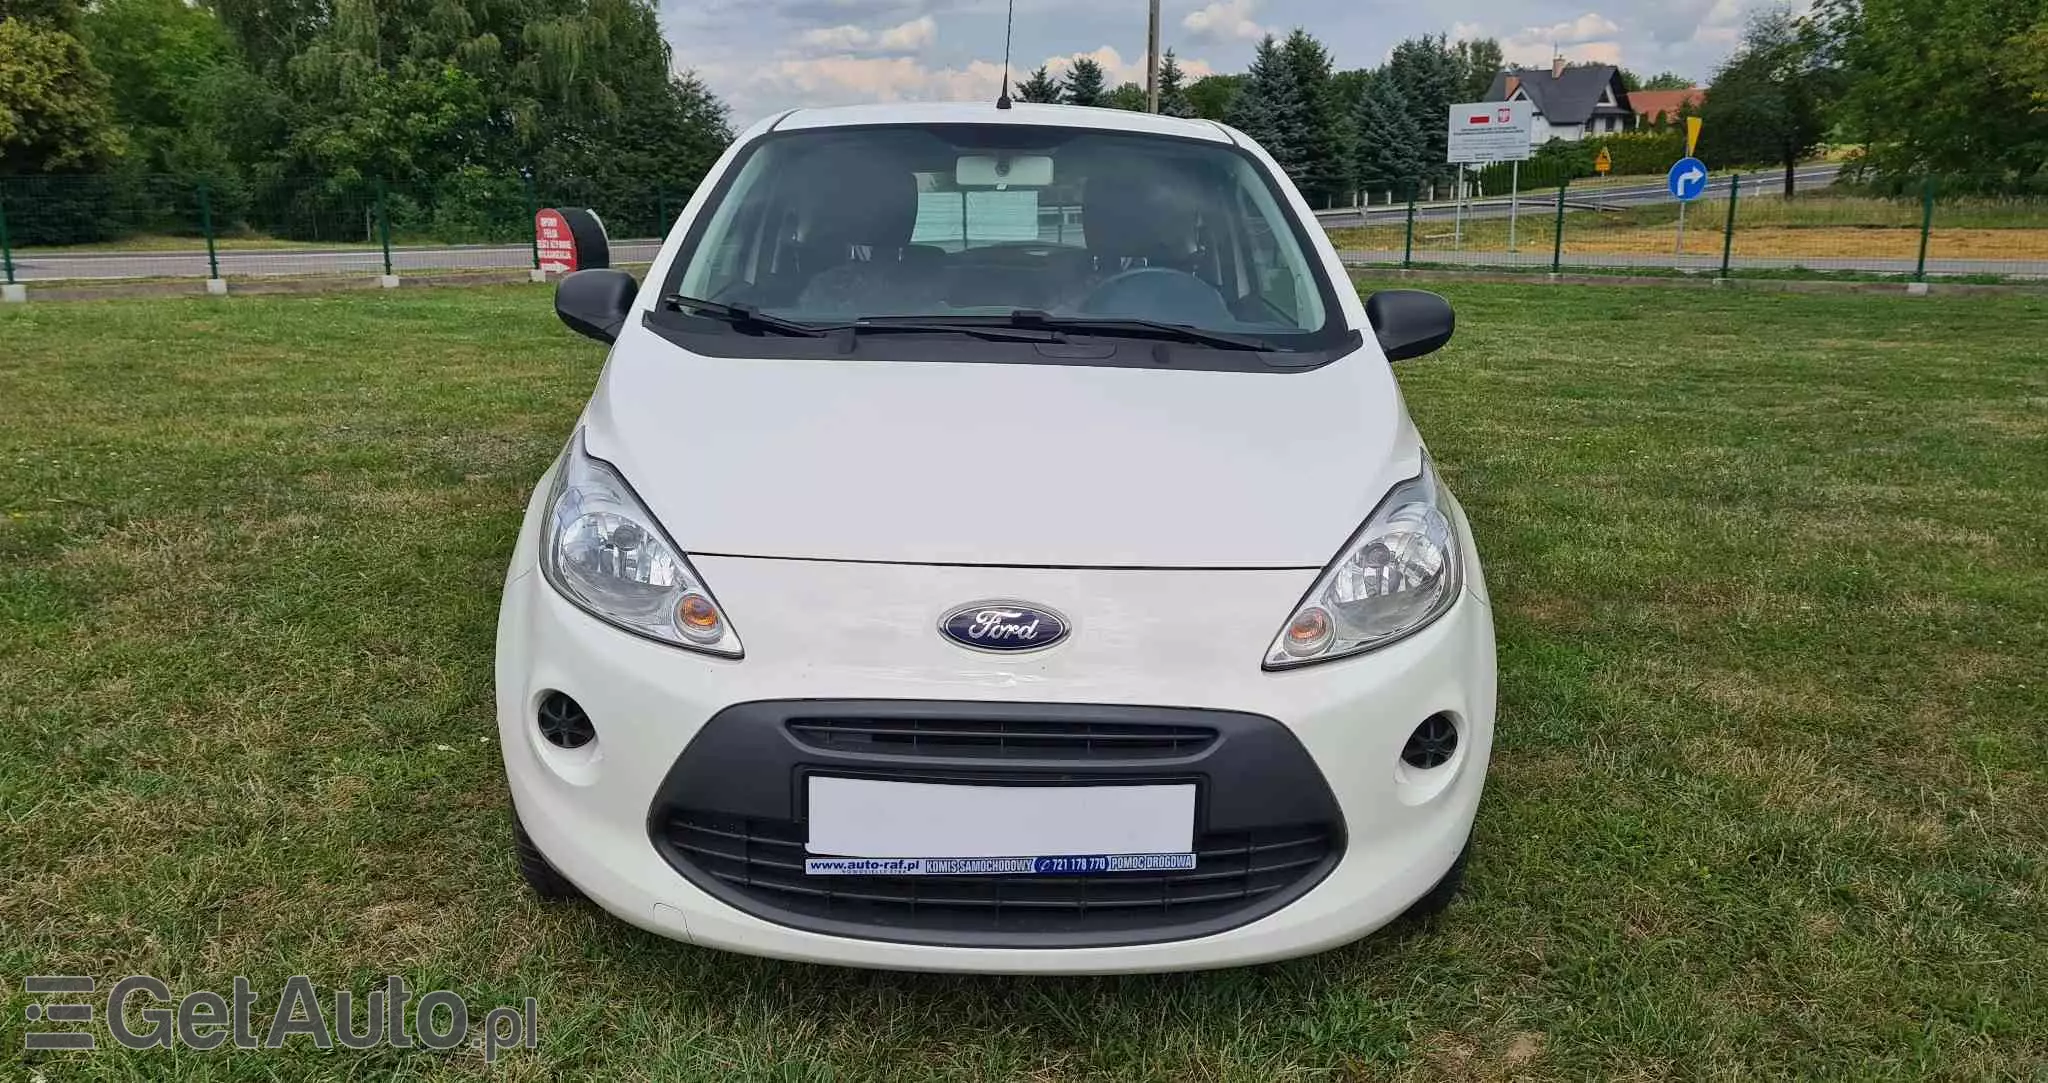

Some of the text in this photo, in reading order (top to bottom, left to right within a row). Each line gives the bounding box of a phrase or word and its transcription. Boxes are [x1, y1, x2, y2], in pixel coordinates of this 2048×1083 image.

[968, 610, 1040, 640] Ford
[810, 859, 920, 871] www.auto-raf.pl
[926, 859, 957, 873] KOMIS
[1052, 858, 1068, 871] 721
[1071, 857, 1087, 870] 178
[1089, 857, 1106, 870] 770
[1111, 856, 1145, 870] POMOC
[1146, 854, 1193, 868] DROGOWA
